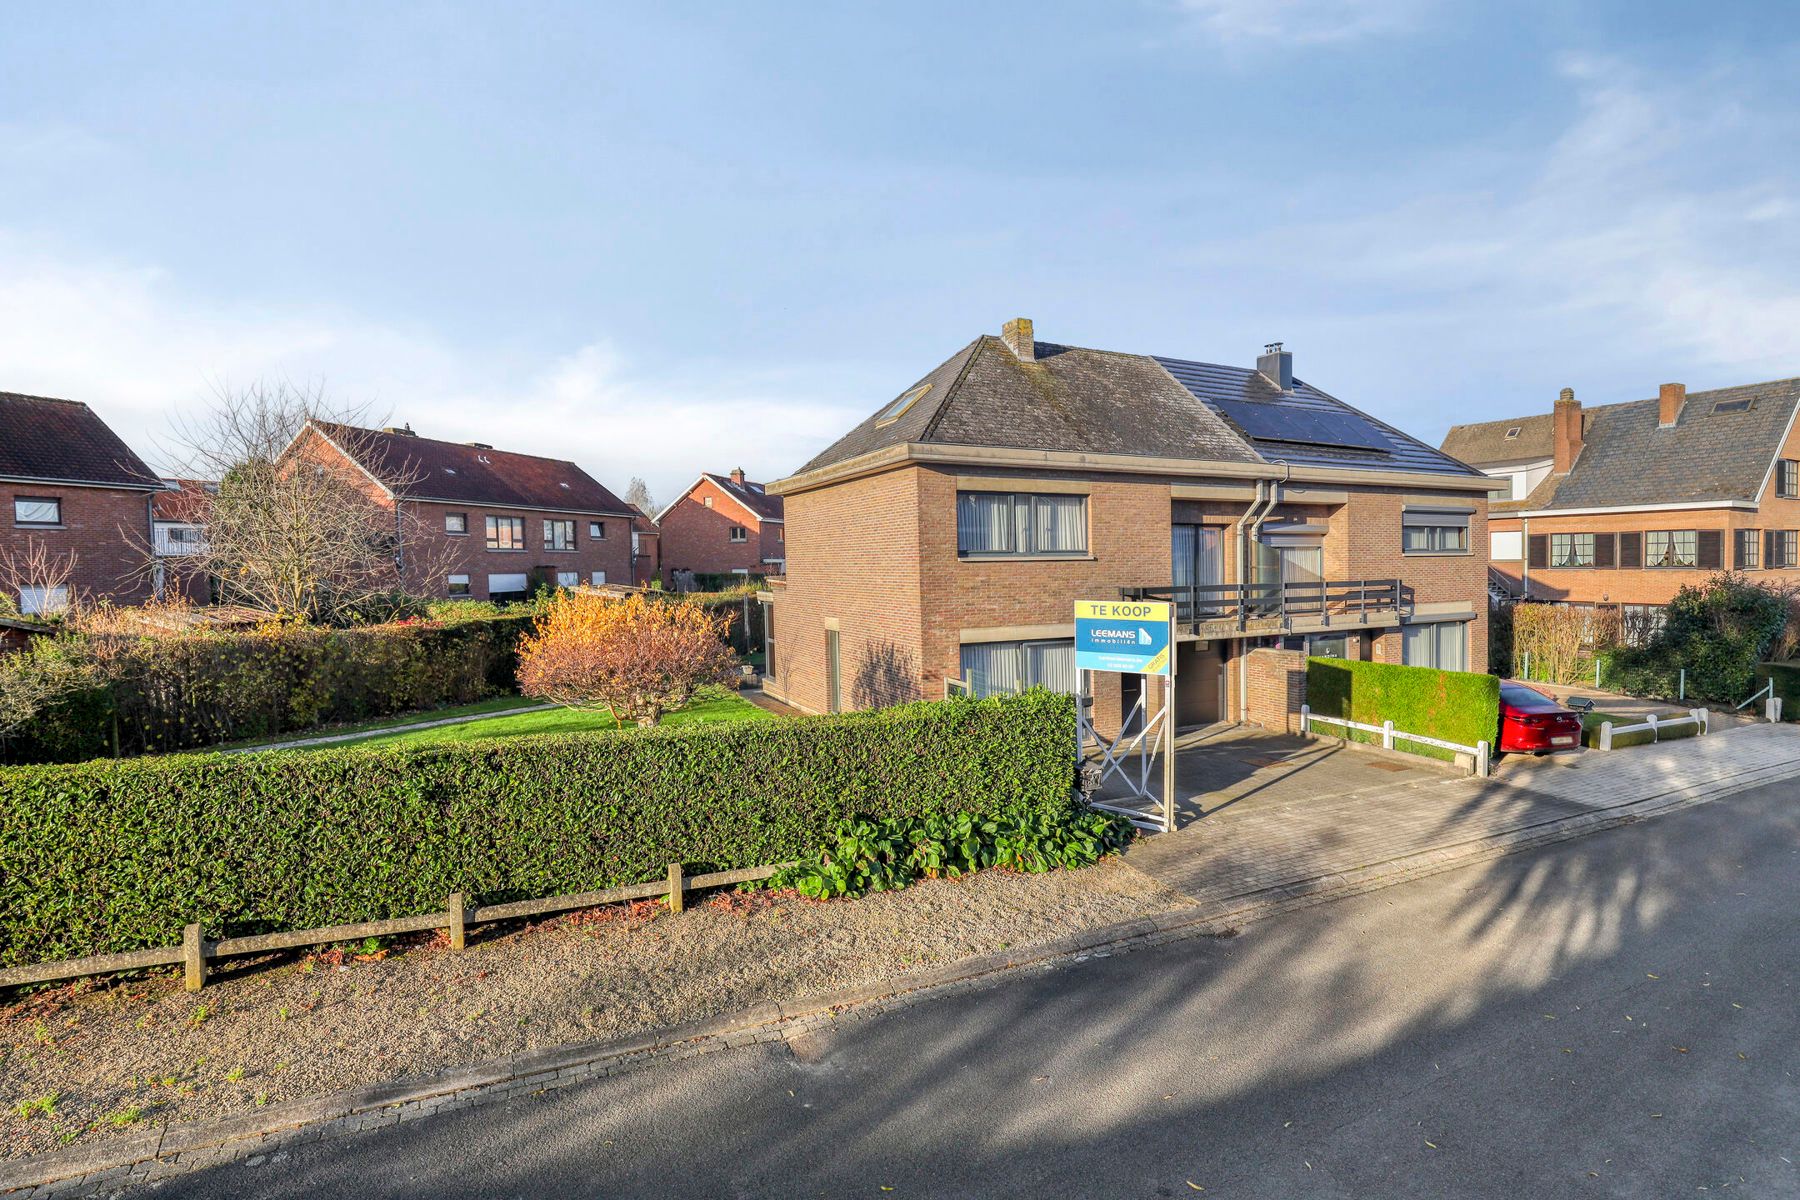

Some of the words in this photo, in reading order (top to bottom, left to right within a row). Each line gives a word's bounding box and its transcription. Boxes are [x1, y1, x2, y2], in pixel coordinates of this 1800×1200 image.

[1091, 605, 1107, 616] TE
[1112, 606, 1151, 617] KOOP
[1091, 629, 1136, 639] LEEMANS
